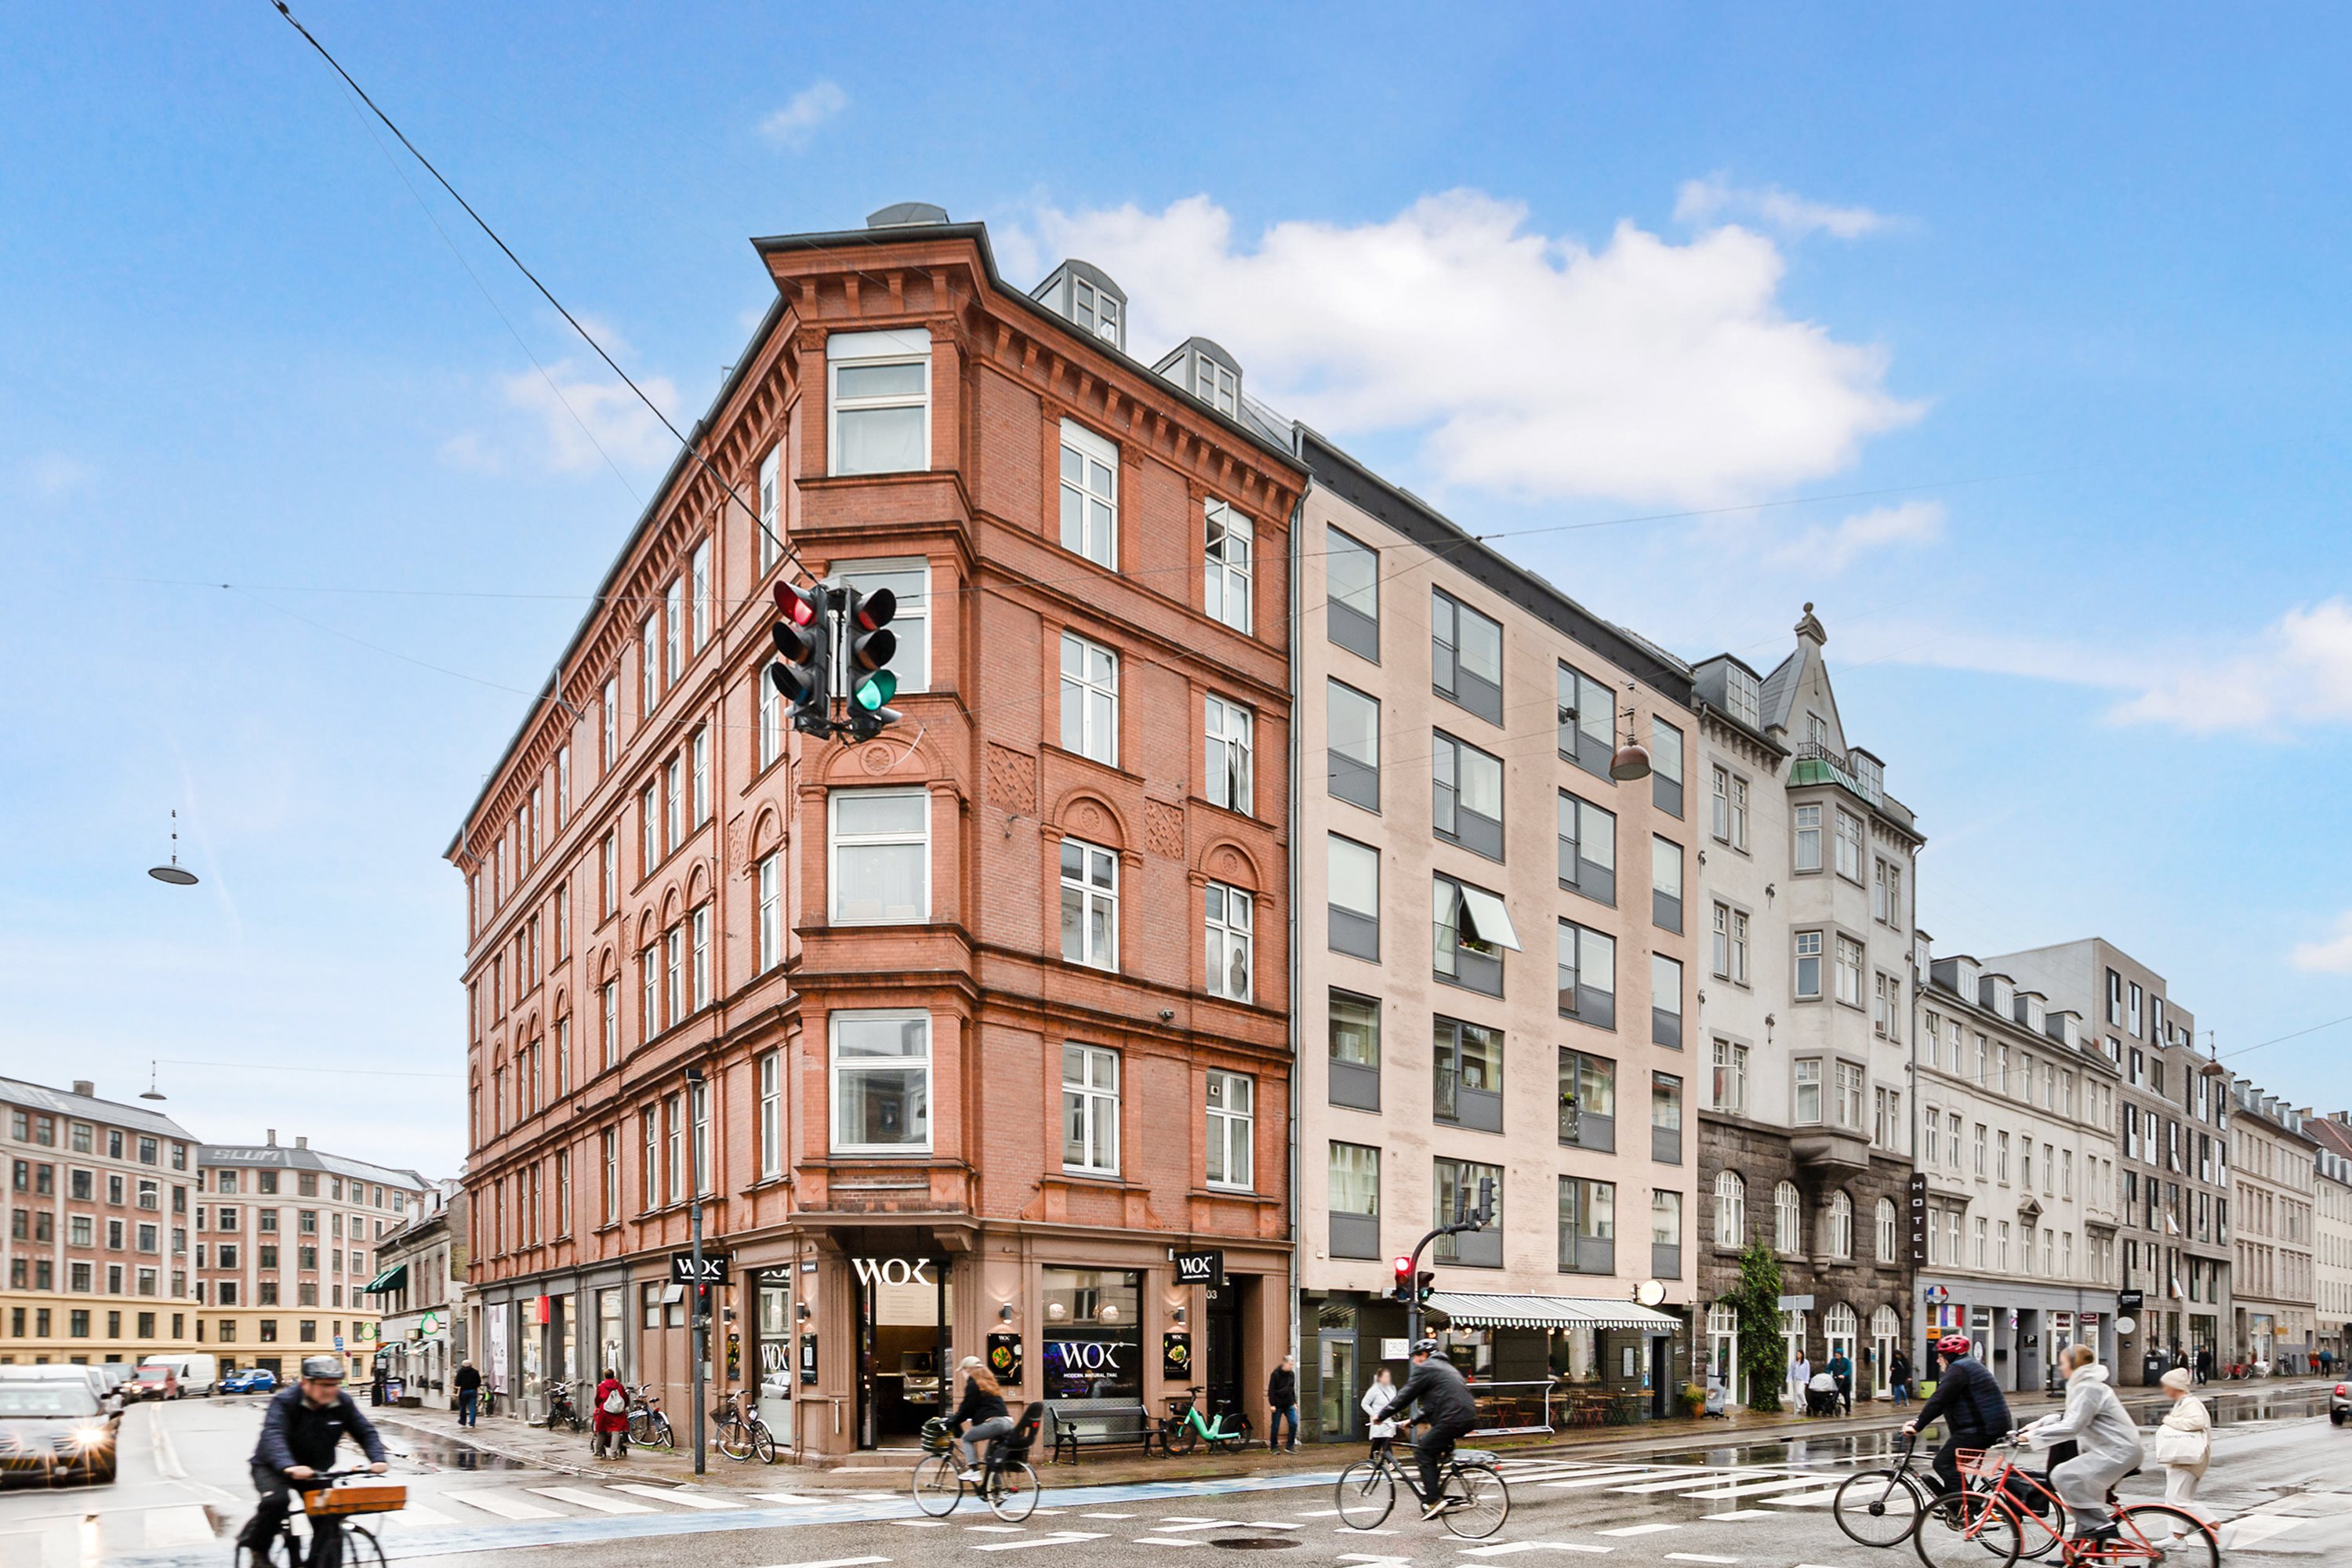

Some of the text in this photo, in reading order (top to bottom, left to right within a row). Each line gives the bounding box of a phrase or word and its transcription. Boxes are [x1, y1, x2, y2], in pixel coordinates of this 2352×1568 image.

[1912, 1181, 1924, 1259] HOTEL
[851, 1258, 932, 1287] WOK
[1179, 1257, 1211, 1274] WOK
[2027, 1335, 2035, 1344] P
[760, 1345, 789, 1370] WOK
[1058, 1342, 1120, 1369] WOK
